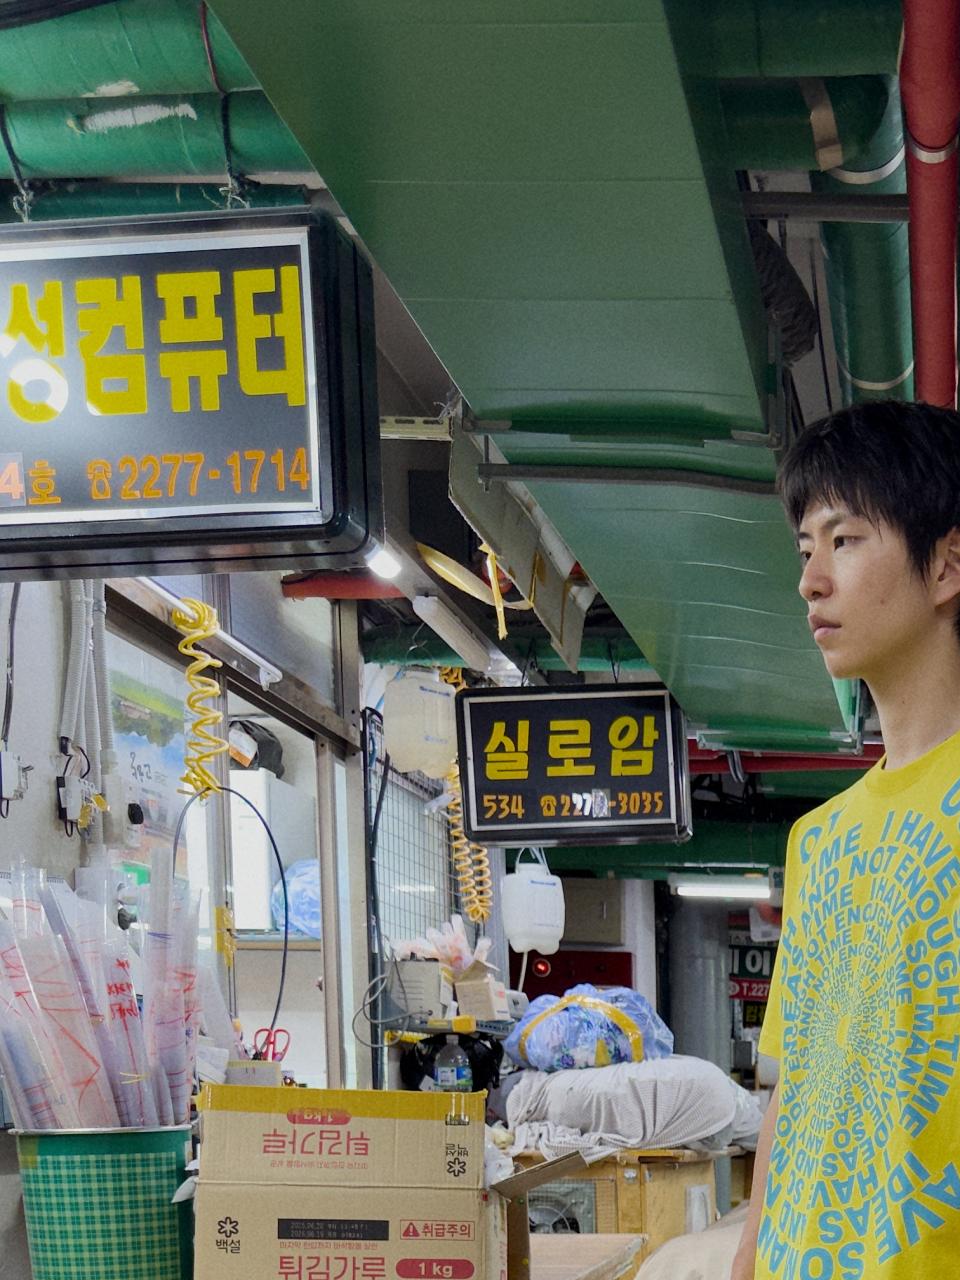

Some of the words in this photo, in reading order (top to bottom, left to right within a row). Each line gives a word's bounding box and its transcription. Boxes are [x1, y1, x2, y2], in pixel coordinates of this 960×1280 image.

[5, 265, 306, 423] 성컴퓨터
[119, 447, 311, 501] 2277-1714
[484, 716, 659, 781] 실로암
[483, 794, 525, 819] 534
[421, 1223, 471, 1239] 취급주의
[216, 1240, 240, 1254] 백설
[418, 1262, 425, 1276] 1
[432, 1261, 453, 1279] kg
